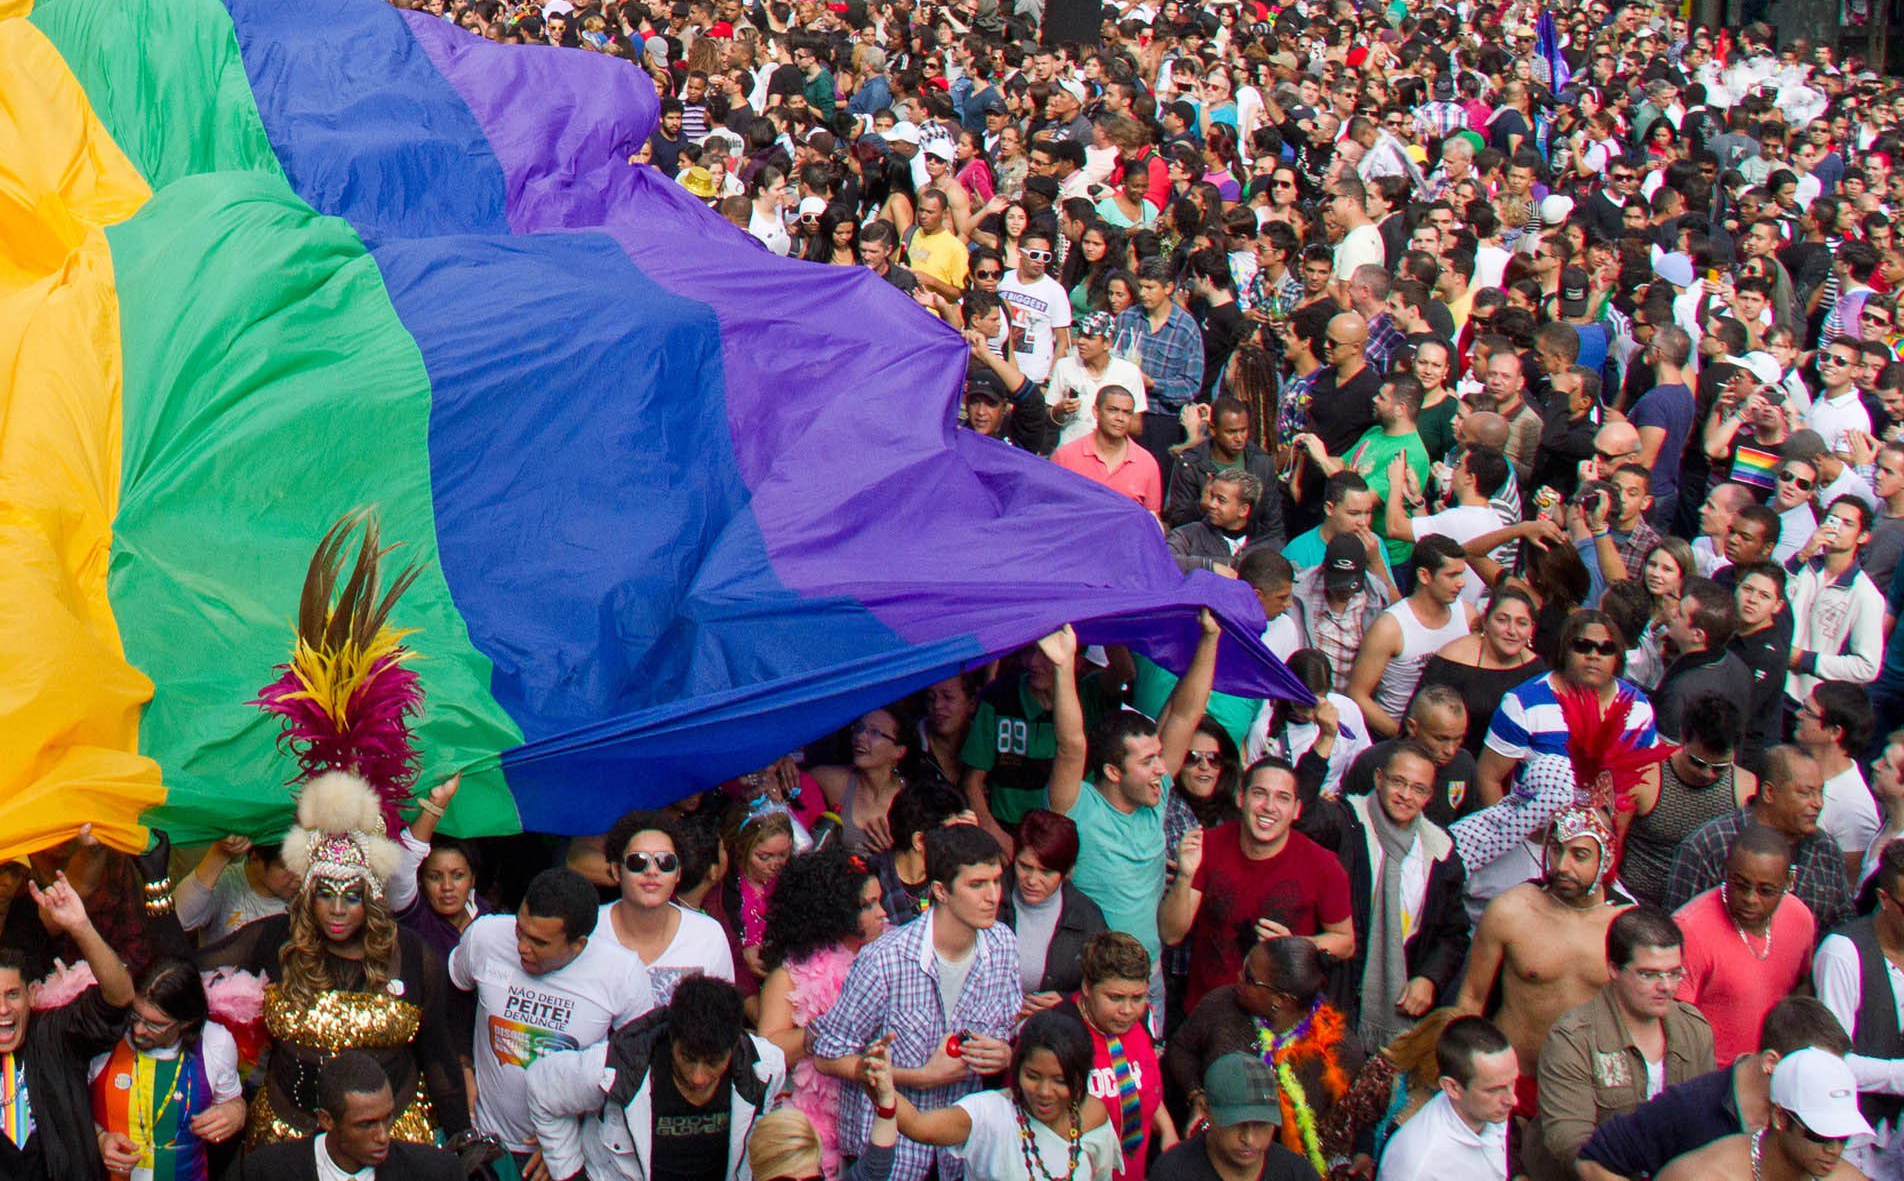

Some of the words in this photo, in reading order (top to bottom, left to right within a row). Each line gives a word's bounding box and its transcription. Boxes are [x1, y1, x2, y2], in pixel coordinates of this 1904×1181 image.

[1007, 292, 1047, 312] BIGGEST
[998, 719, 1027, 755] 89
[504, 1010, 565, 1031] DENUNCIE
[506, 995, 571, 1024] PEITE!
